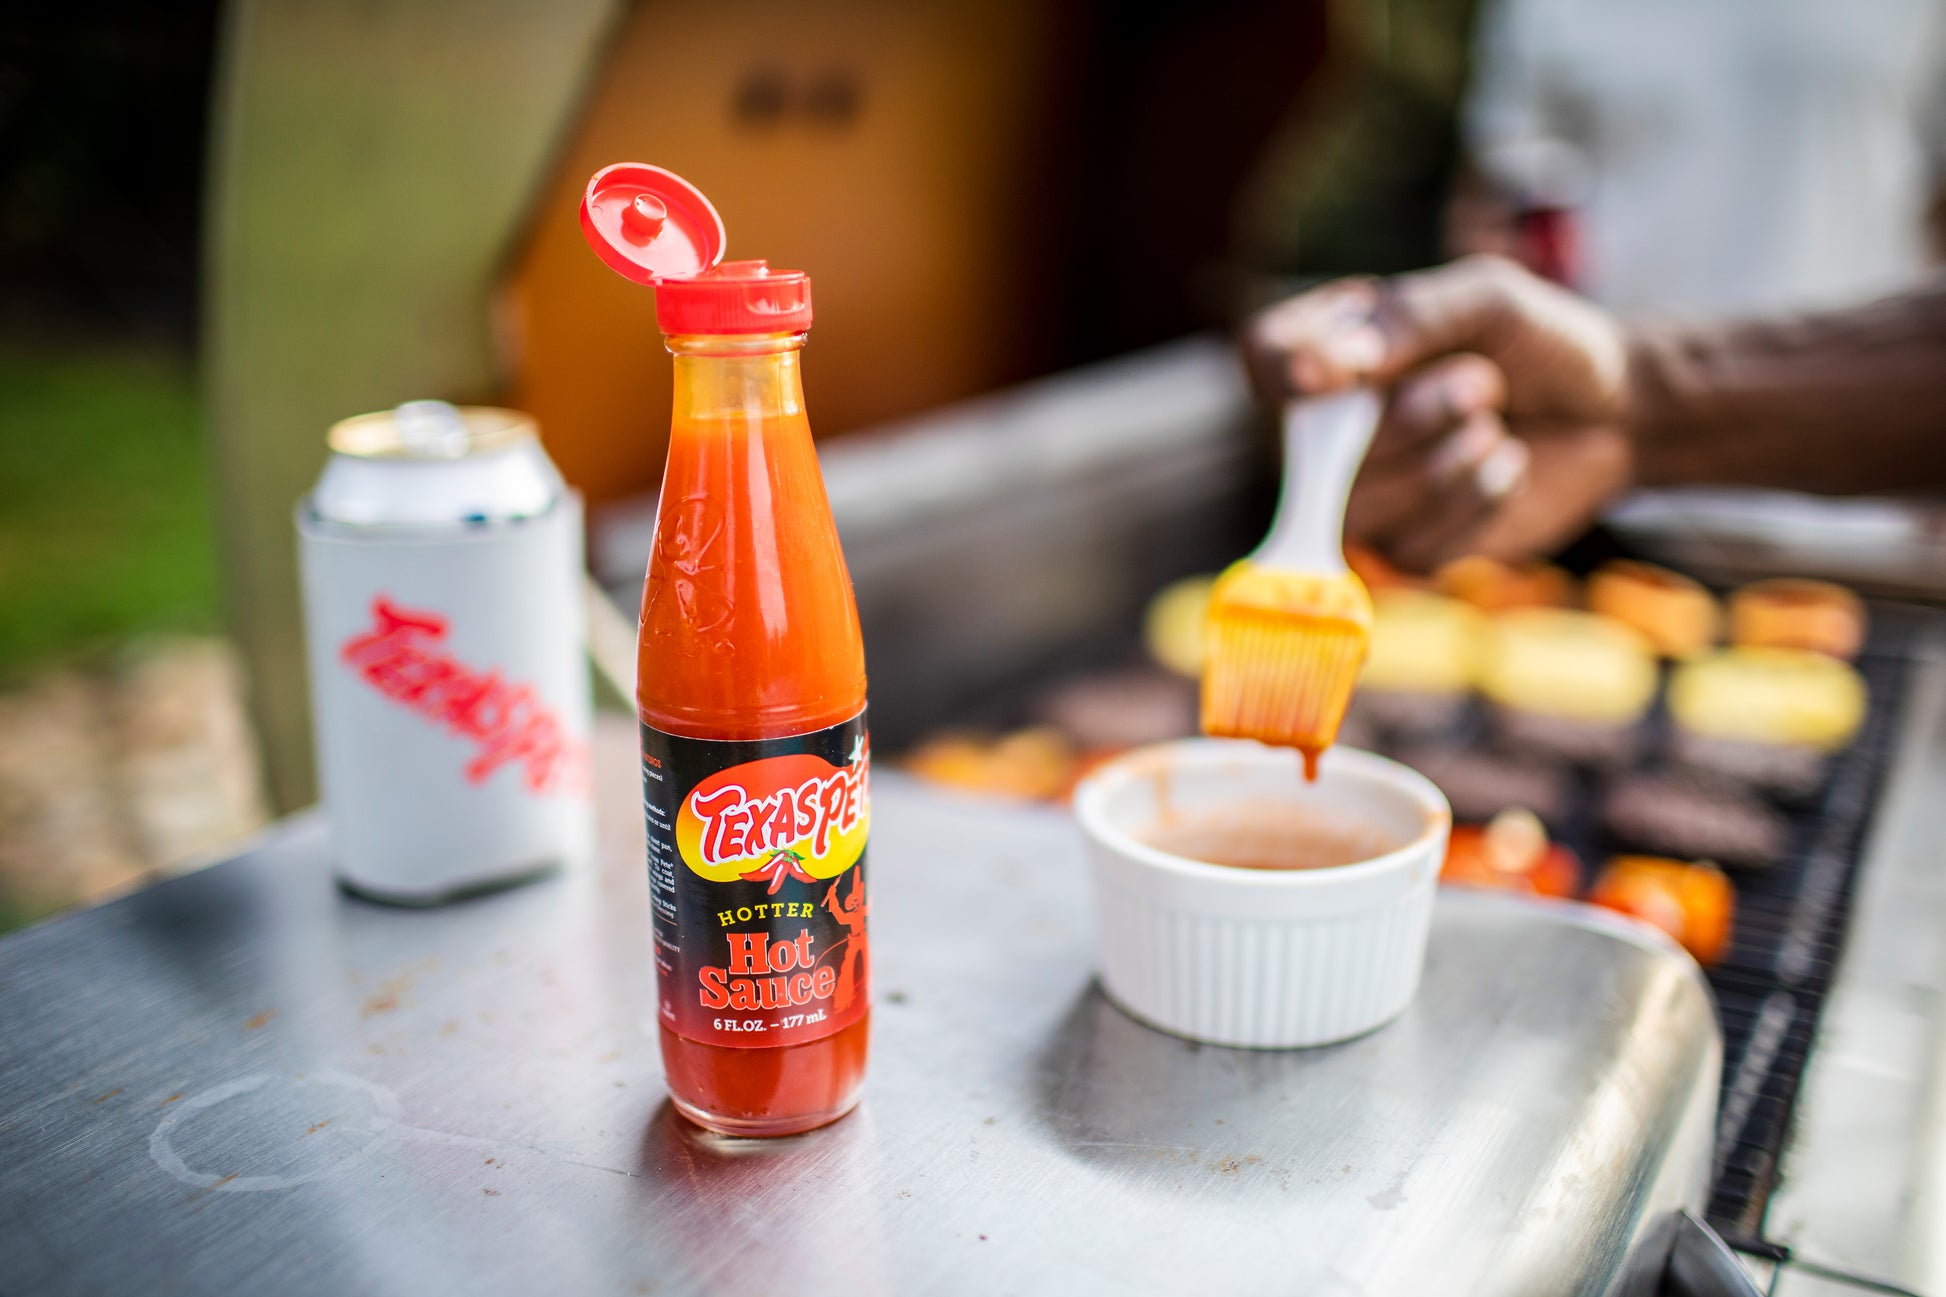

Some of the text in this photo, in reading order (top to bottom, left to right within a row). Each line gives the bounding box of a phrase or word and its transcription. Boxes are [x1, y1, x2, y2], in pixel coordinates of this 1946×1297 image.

[717, 902, 814, 927] HOTTER
[726, 928, 815, 975] Hot
[698, 965, 836, 1011] Sauce
[713, 1018, 723, 1030] 6
[782, 1013, 804, 1029] 177
[806, 1008, 828, 1025] mL
